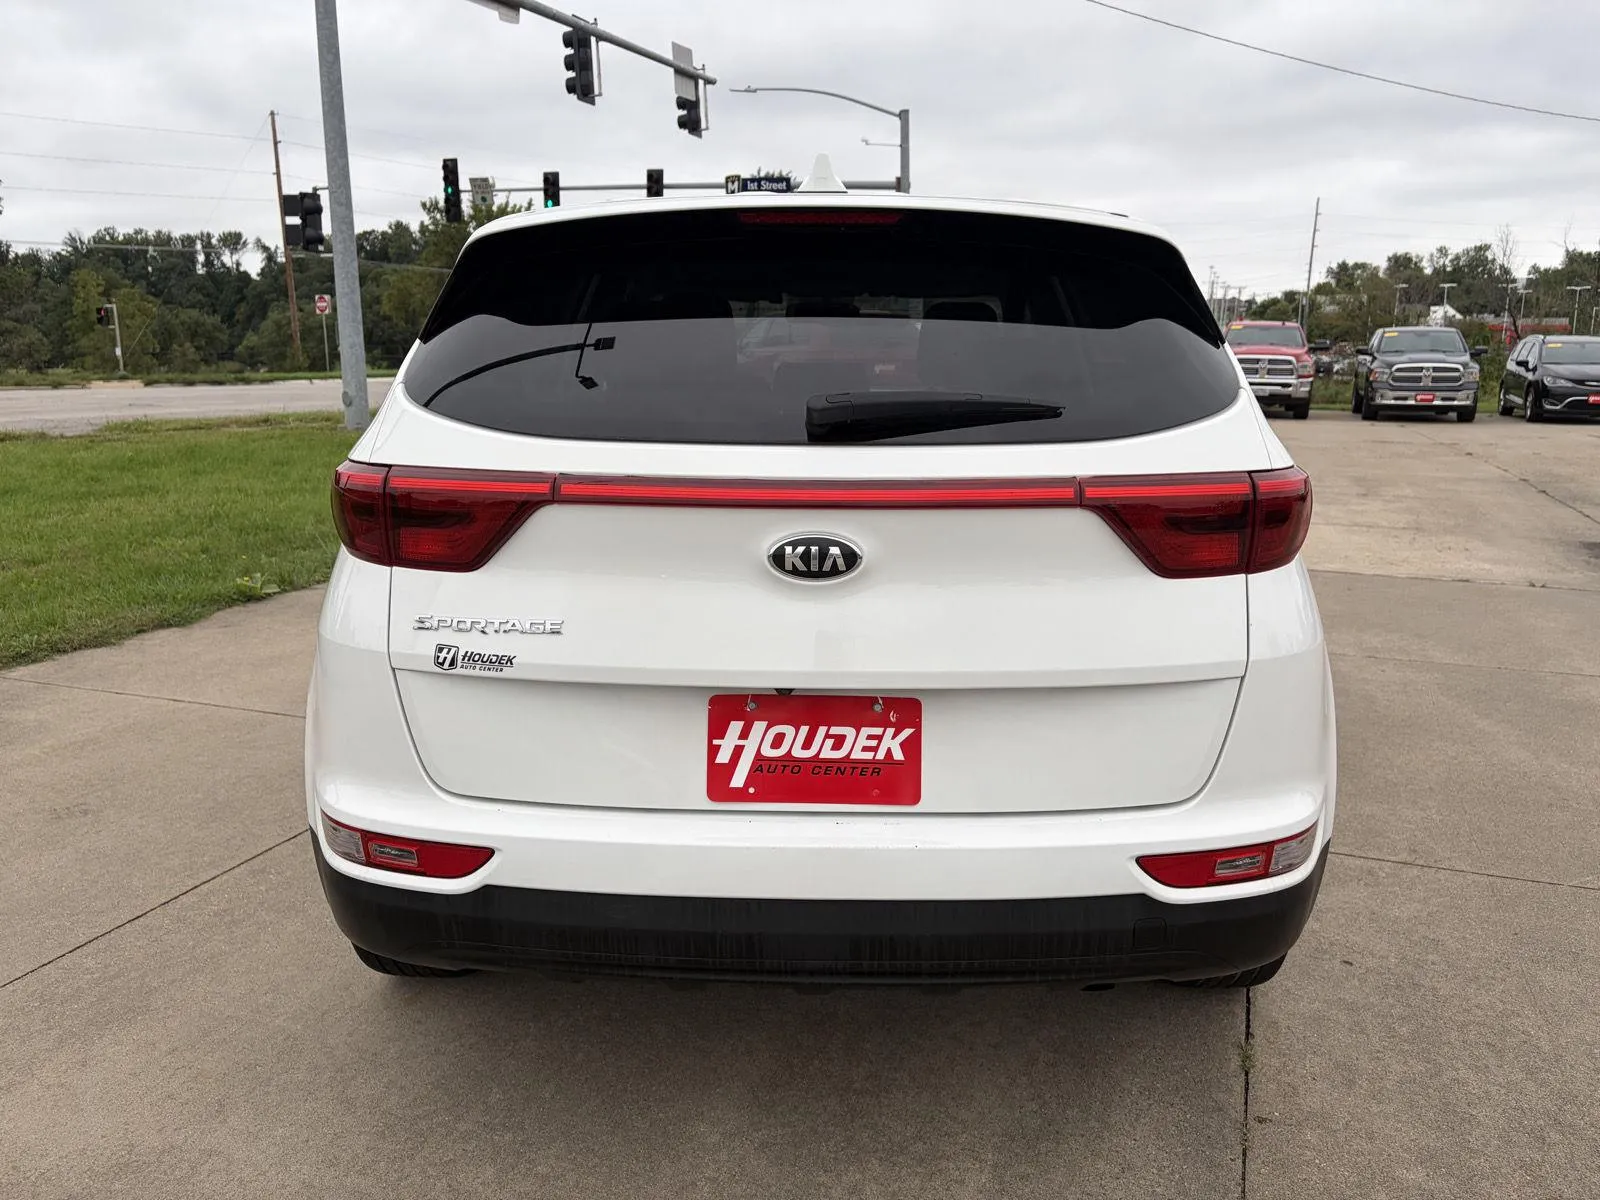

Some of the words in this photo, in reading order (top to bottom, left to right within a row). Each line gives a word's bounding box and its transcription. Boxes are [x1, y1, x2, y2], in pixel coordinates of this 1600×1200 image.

[747, 181, 758, 190] 1st
[760, 181, 787, 190] Street
[784, 545, 847, 572] KIA
[413, 614, 564, 635] SPORTAGE
[460, 650, 517, 666] HOUDEK
[712, 720, 916, 788] HOUDEK
[753, 763, 802, 775] AUTO
[812, 765, 882, 777] CENTER
